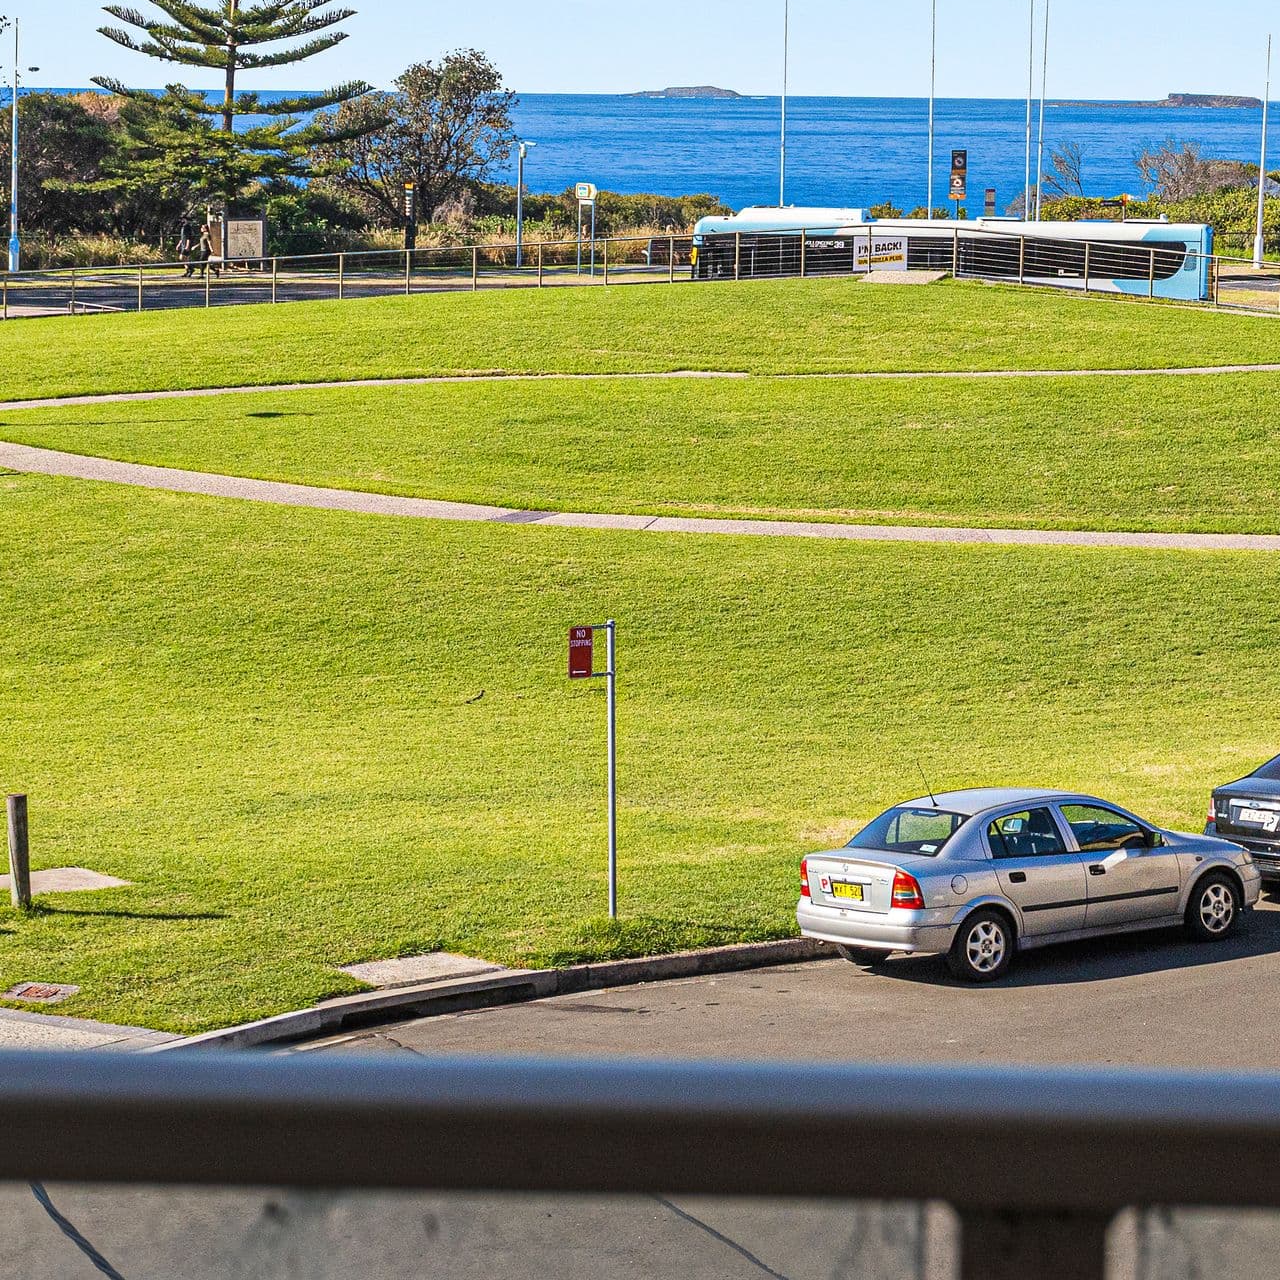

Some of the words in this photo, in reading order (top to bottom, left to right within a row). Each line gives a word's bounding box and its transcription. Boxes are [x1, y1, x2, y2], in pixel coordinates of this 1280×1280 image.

[875, 241, 902, 253] BACK!
[576, 629, 586, 638] NO
[570, 639, 592, 647] STOPPING
[821, 878, 828, 889] P
